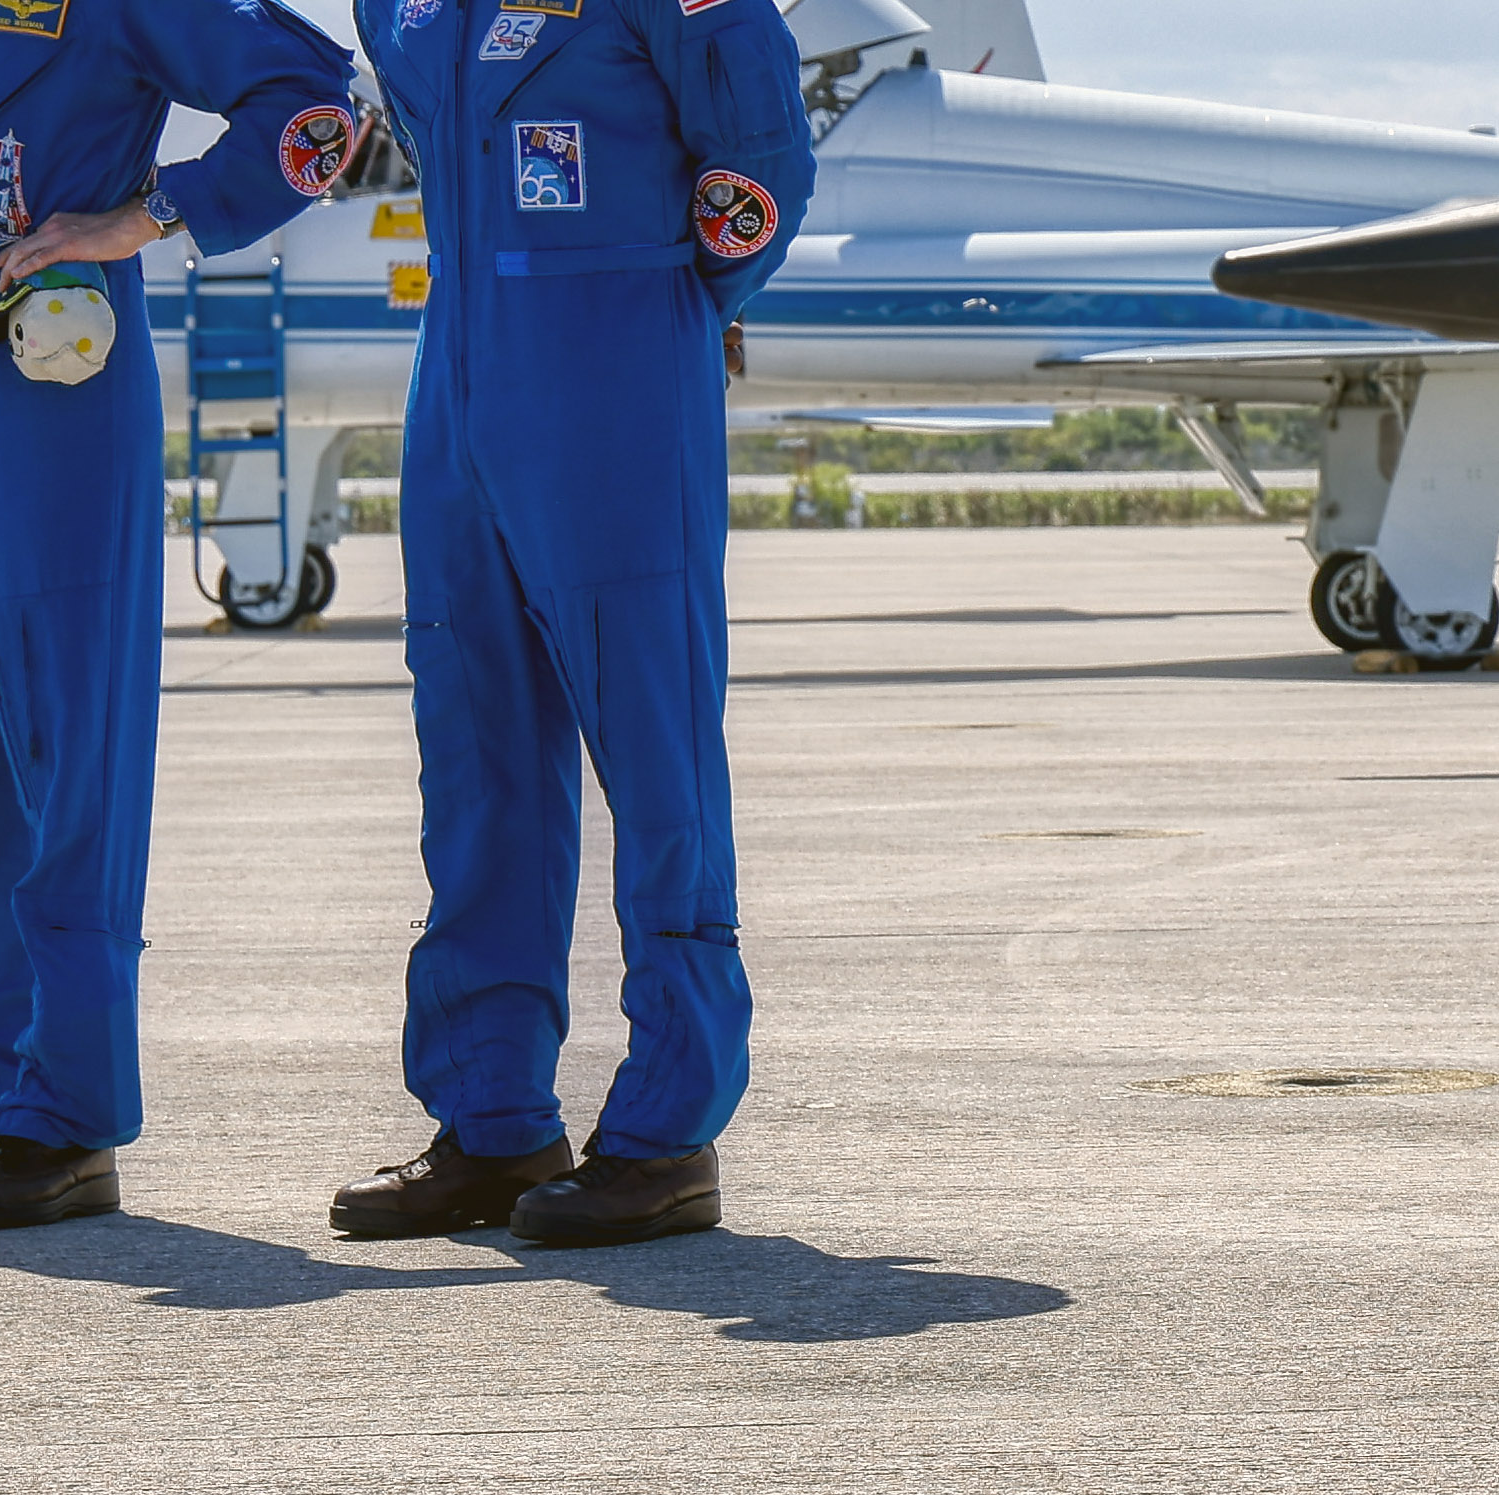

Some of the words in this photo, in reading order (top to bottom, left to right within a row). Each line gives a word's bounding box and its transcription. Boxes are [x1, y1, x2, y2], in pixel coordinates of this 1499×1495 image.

[521, 164, 562, 205] 65
[726, 174, 749, 188] NASA
[729, 247, 749, 255] RED
[749, 229, 772, 251] GLARE
